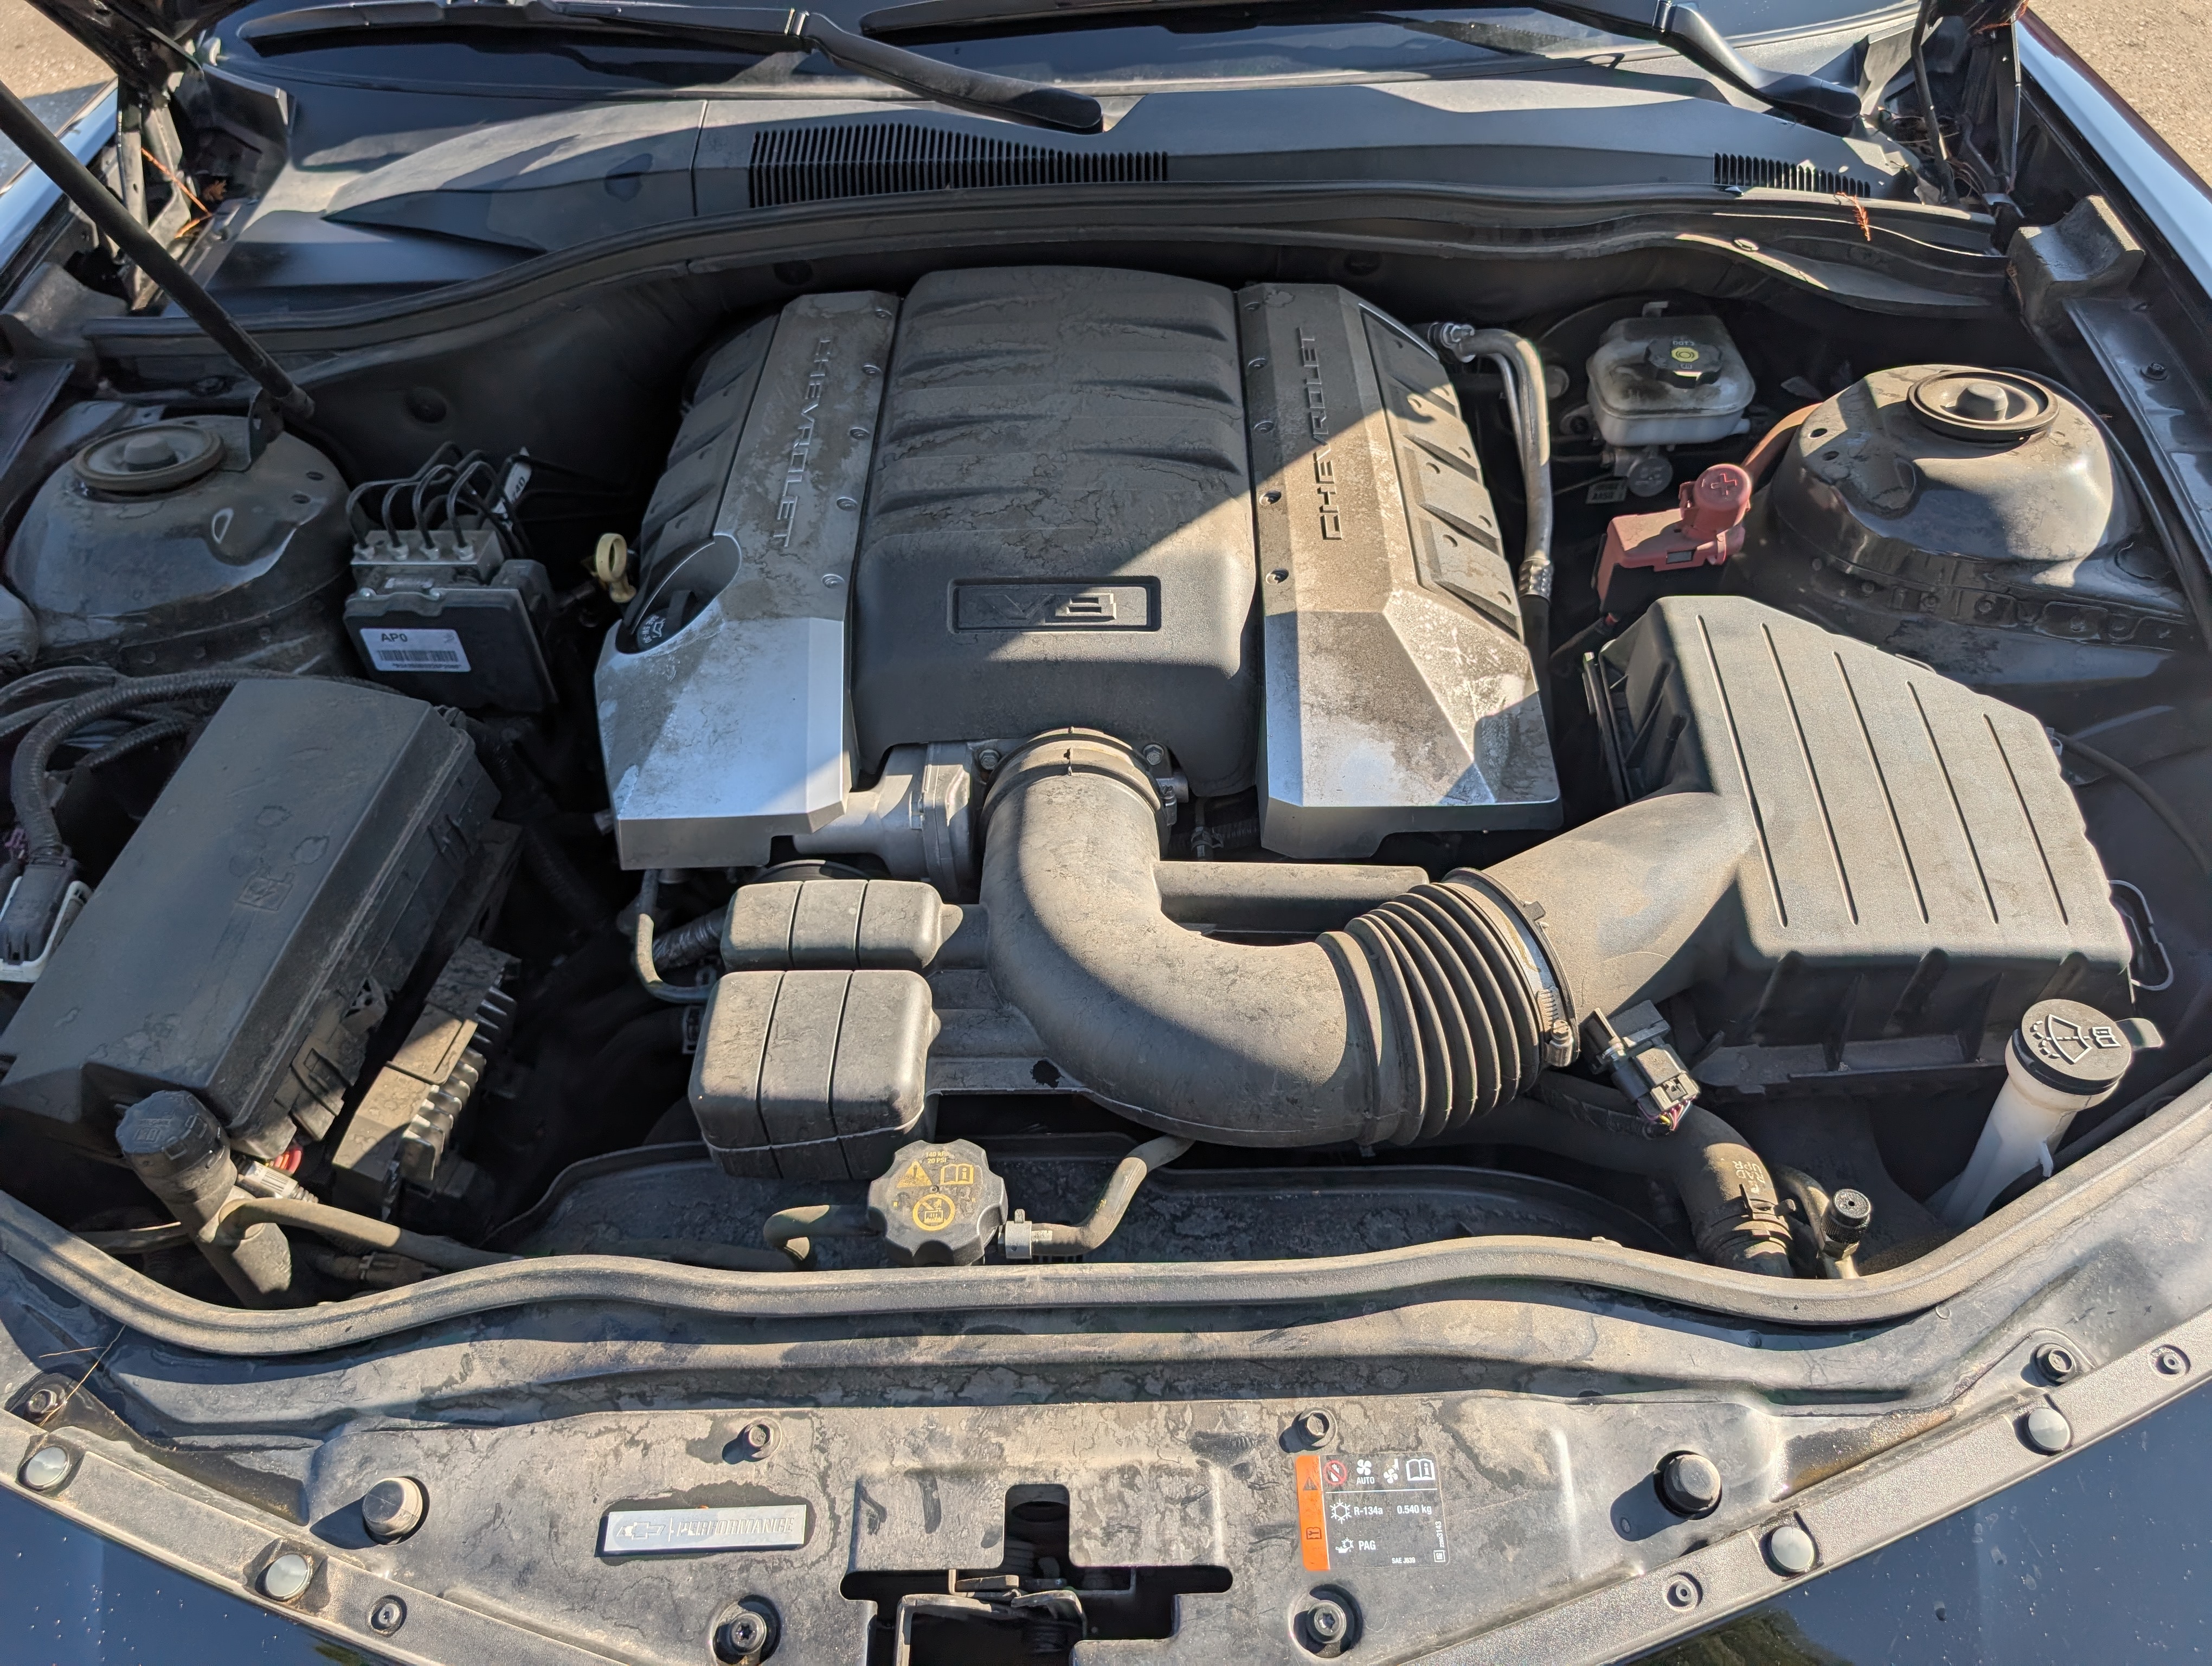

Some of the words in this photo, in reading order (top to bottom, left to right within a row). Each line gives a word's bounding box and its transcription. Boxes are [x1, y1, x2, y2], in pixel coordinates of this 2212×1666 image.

[1296, 327, 1342, 540] CHEVROLET
[774, 339, 832, 548] CHEVROLET
[1356, 1477, 1375, 1485] AUTO
[1354, 1506, 1383, 1515] R-134a
[1397, 1505, 1419, 1514] 0.540
[1422, 1505, 1432, 1515] kg
[677, 1517, 794, 1537] PERFORMANCE
[1359, 1541, 1376, 1550] PAG
